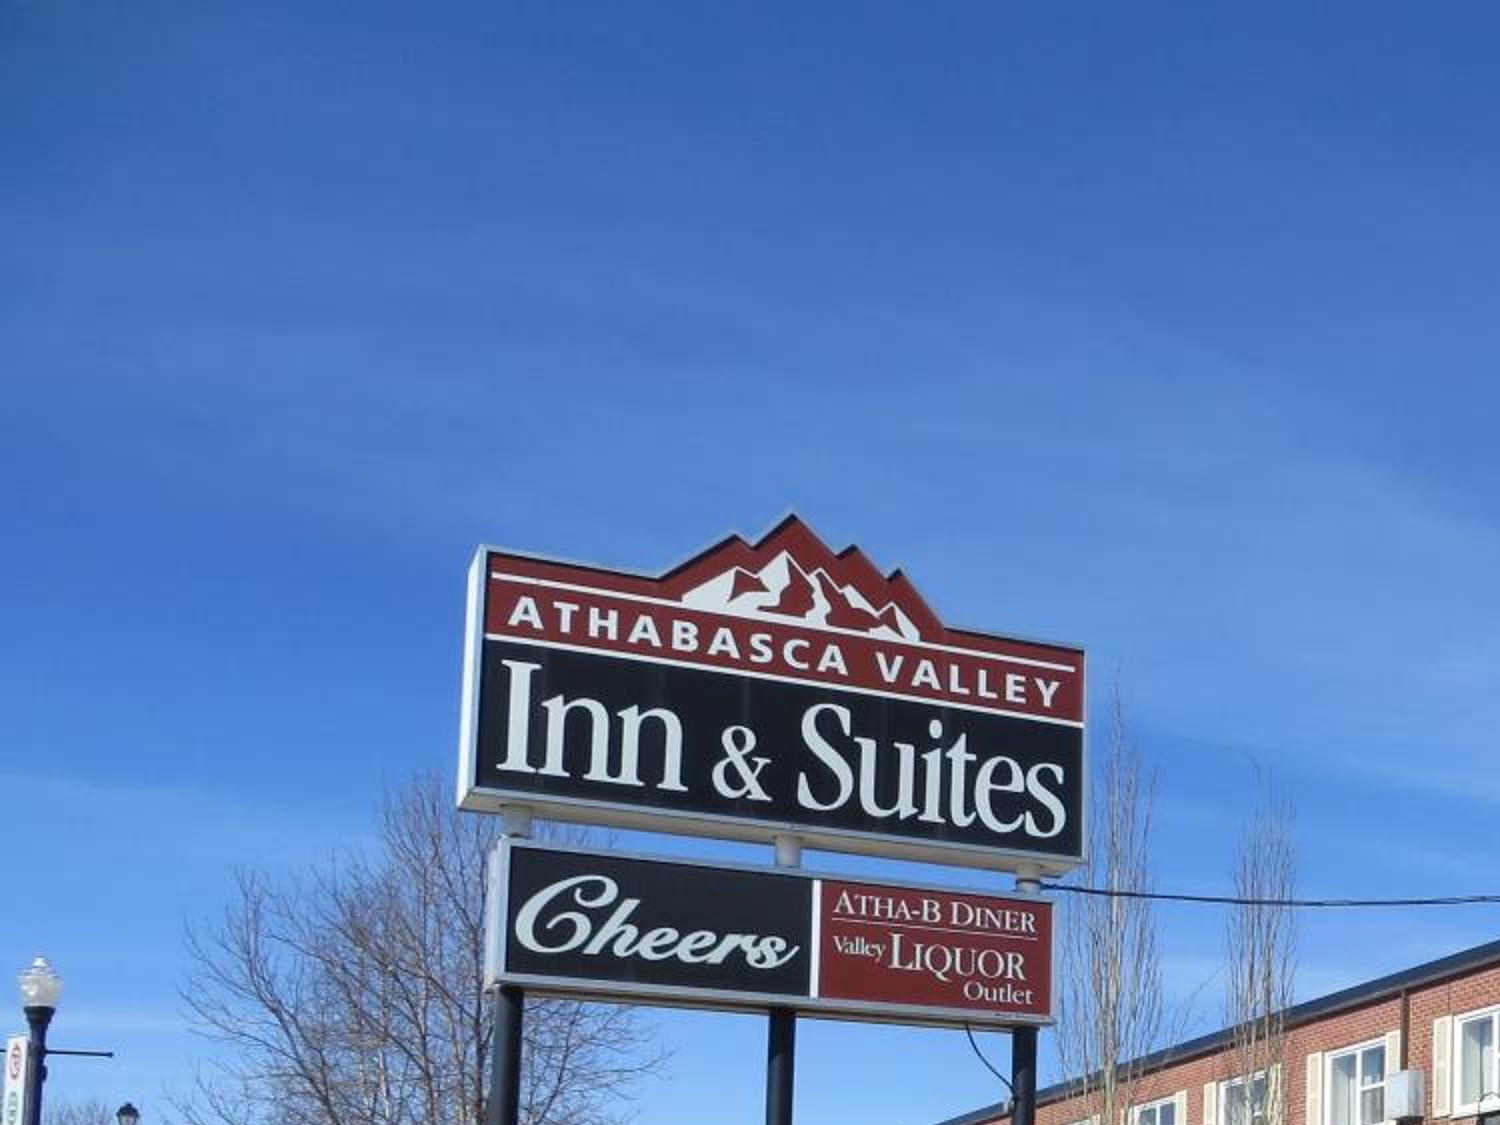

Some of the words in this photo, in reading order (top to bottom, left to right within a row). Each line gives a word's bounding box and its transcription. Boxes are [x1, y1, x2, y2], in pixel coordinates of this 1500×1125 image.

[508, 597, 849, 676] ATHABASCA
[877, 651, 1060, 707] VALLEY
[496, 660, 689, 793] Inn
[711, 725, 772, 802] &
[798, 704, 1066, 838] Suites
[515, 875, 800, 970] Cheers
[833, 889, 941, 924] ATHA-B
[950, 901, 1036, 933] DINER
[832, 935, 887, 964] Valley
[888, 931, 1027, 982] LIQUOR
[962, 980, 1034, 1005] Outlet
